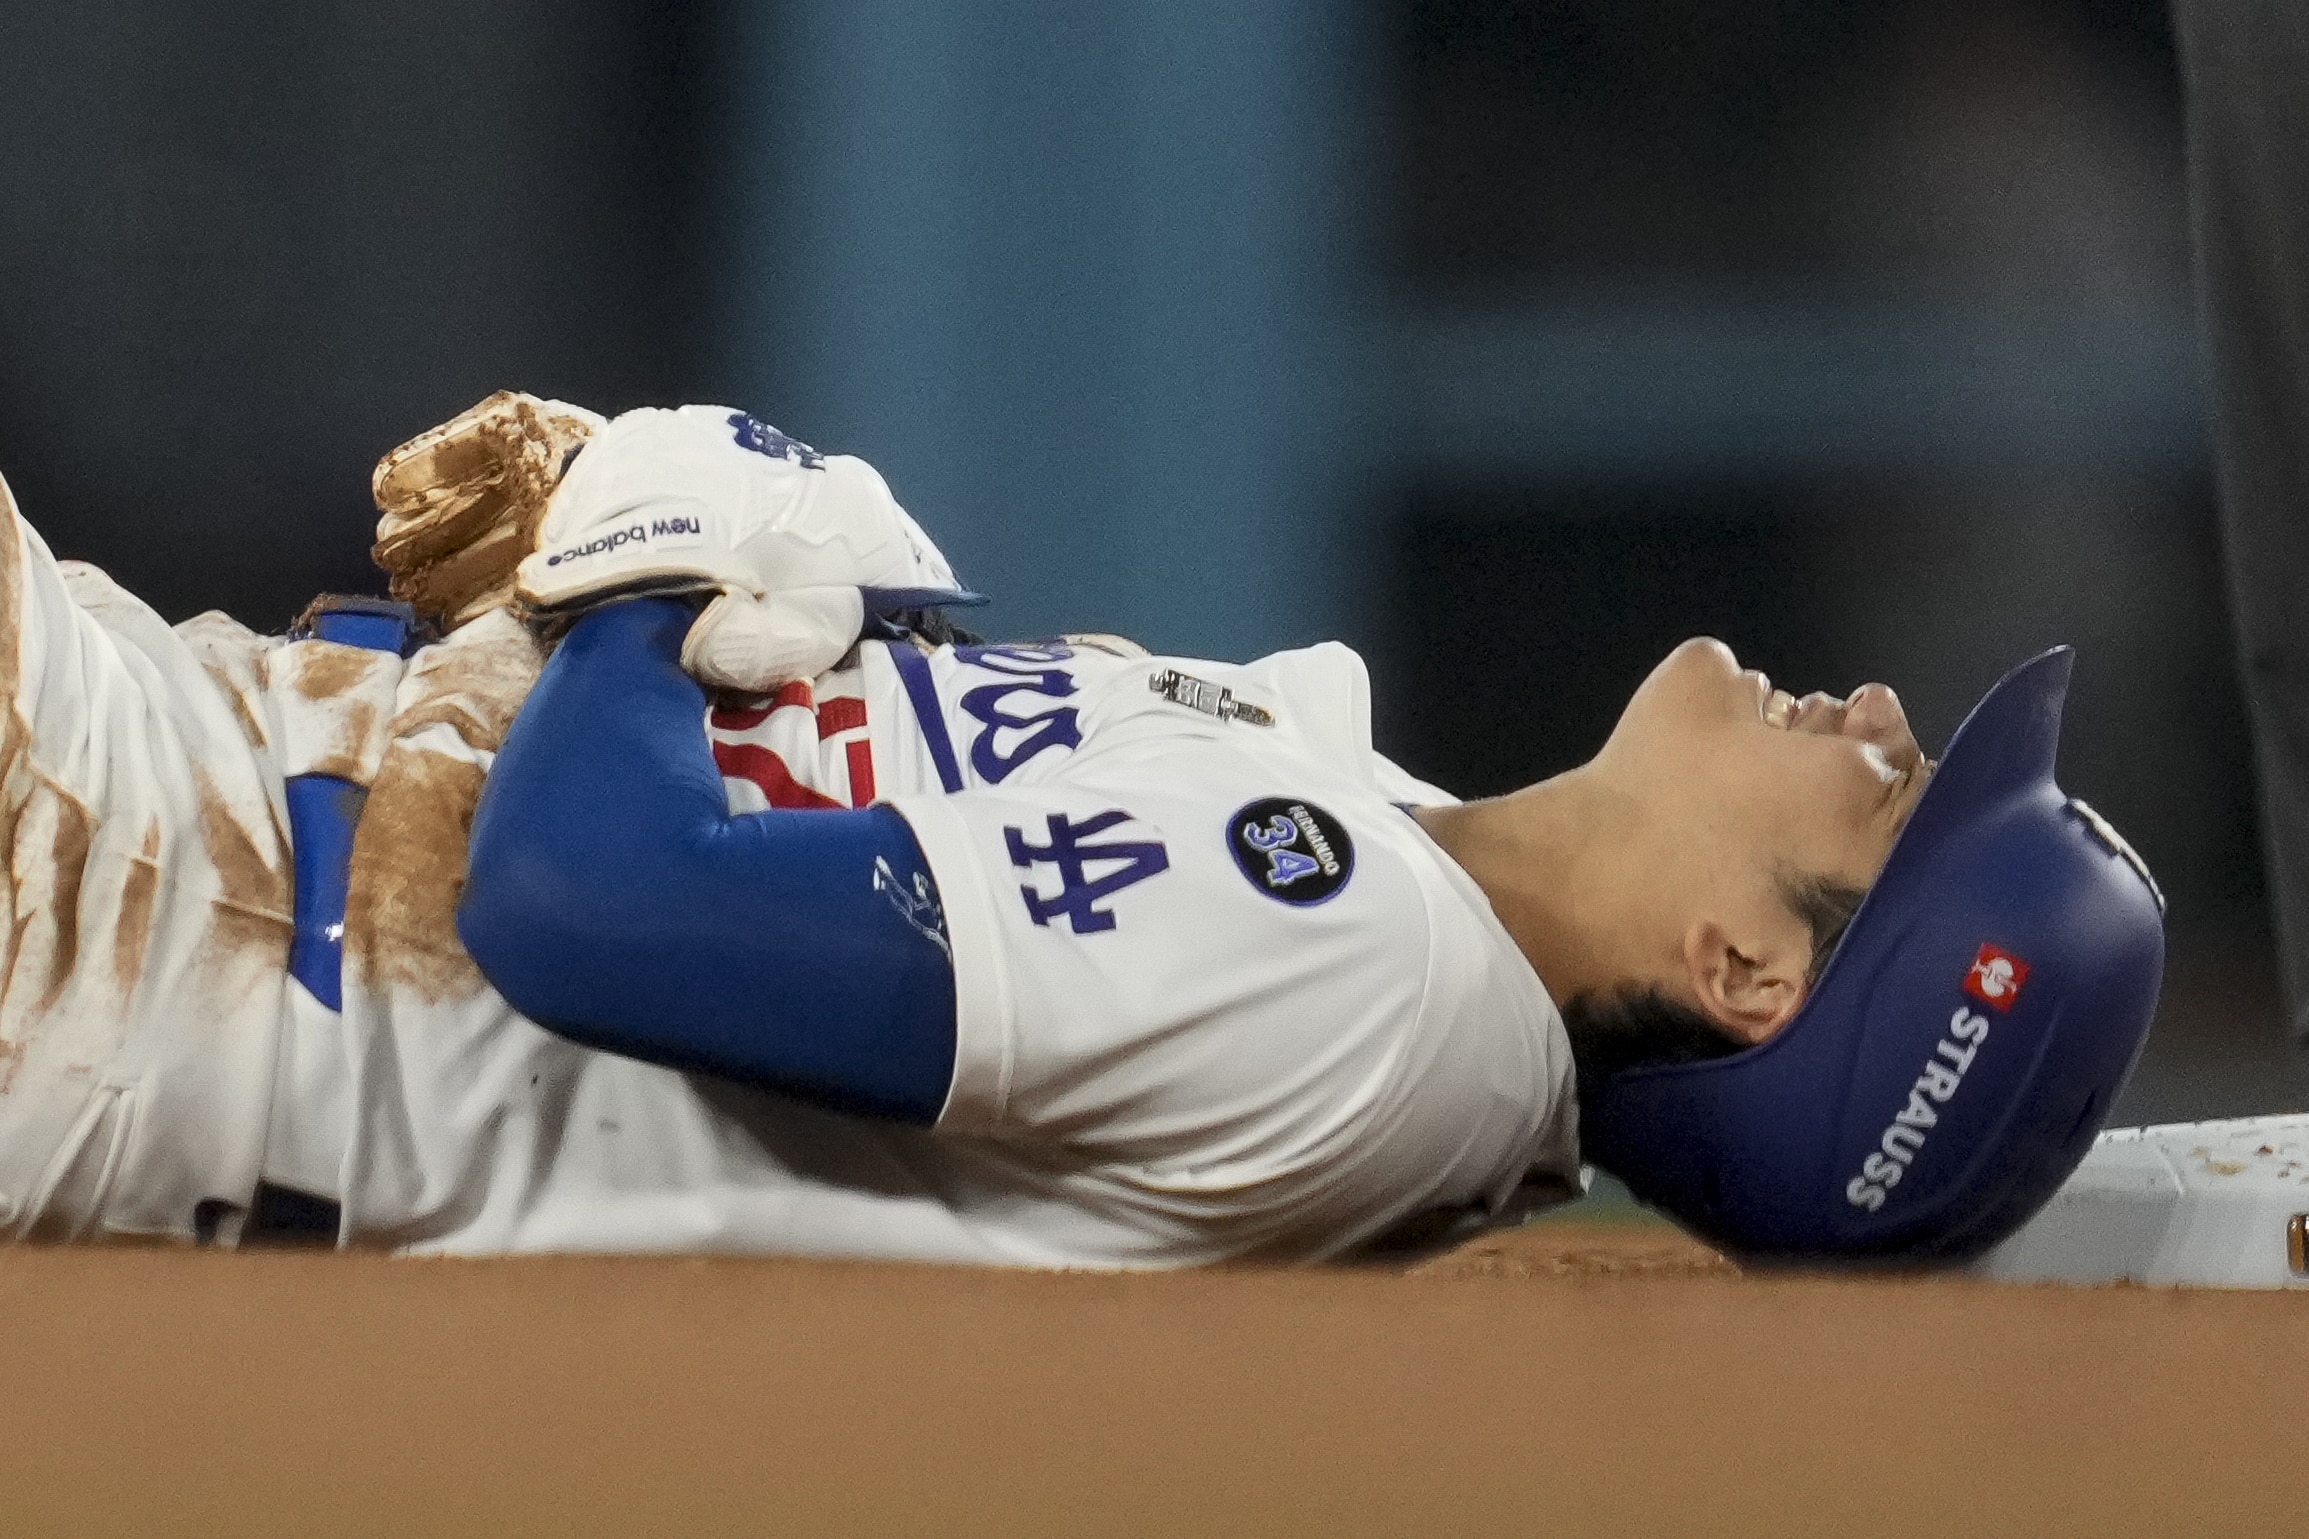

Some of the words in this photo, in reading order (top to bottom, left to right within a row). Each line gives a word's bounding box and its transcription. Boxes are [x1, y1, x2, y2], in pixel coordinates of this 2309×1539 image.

[547, 525, 647, 567] balance
[652, 516, 700, 537] new
[1003, 809, 1170, 934] LA
[1243, 814, 1320, 888] 34
[1287, 804, 1340, 877] FERNANDO
[1846, 1006, 1990, 1213] STRAUSS
